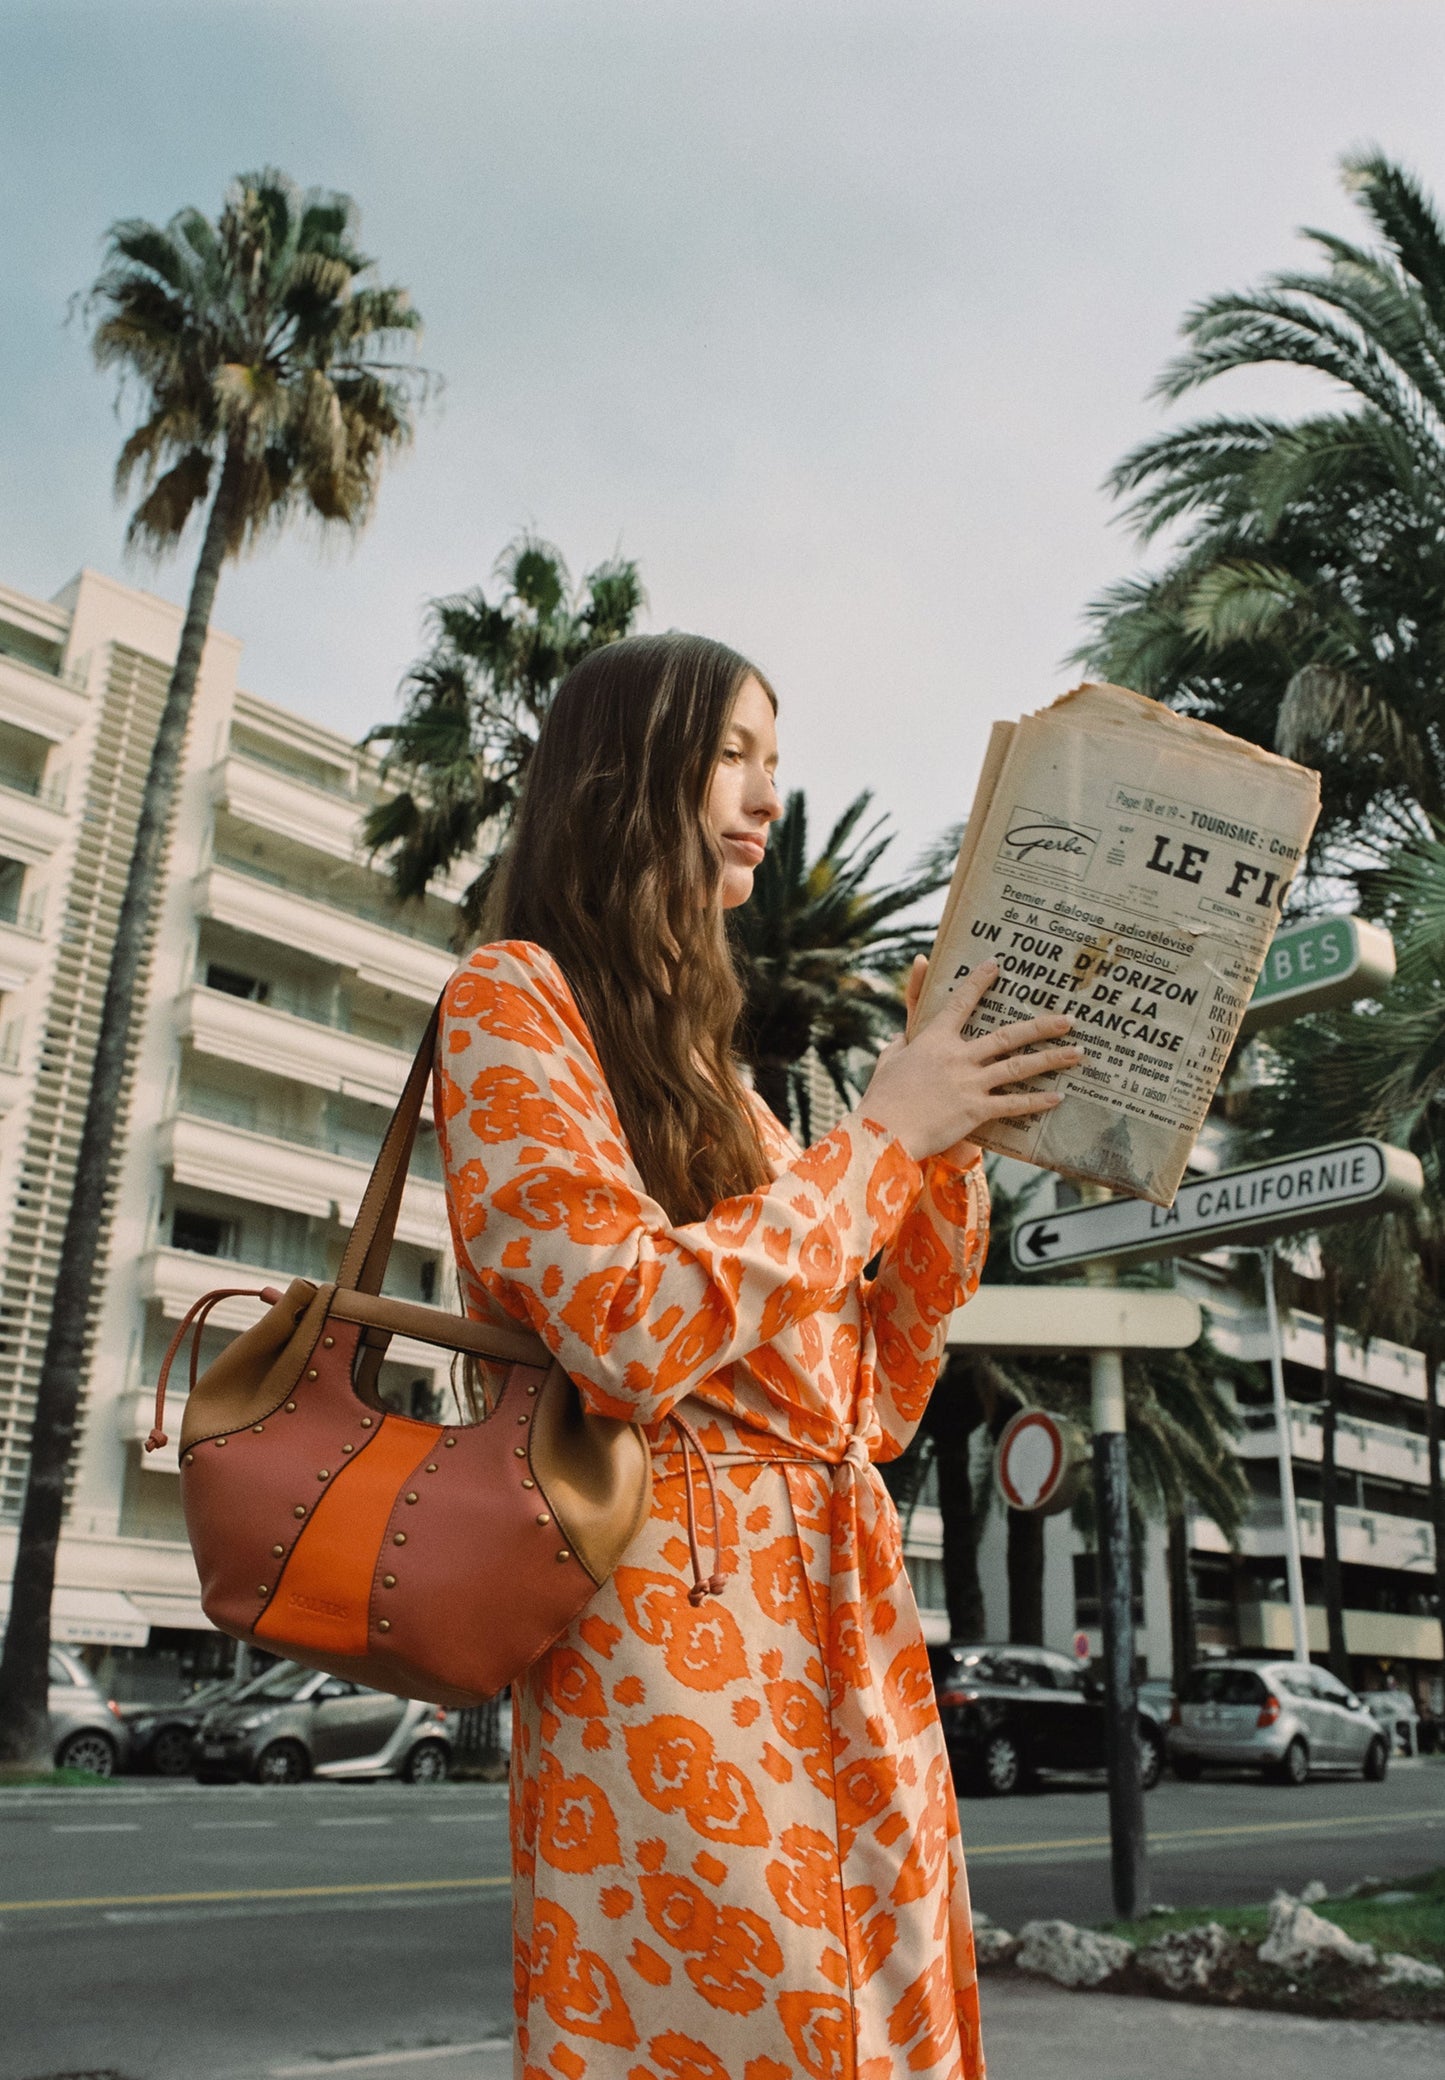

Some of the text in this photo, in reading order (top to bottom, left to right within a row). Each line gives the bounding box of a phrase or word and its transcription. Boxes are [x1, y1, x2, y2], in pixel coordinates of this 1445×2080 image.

[1005, 824, 1097, 861] Gerbe
[1146, 835, 1210, 884] LE
[1269, 838, 1304, 861] Cont
[1003, 884, 1046, 906] Premier
[1053, 901, 1105, 927] dialogue
[1004, 907, 1020, 921] de
[1049, 920, 1098, 946] Georges
[1106, 938, 1170, 969] ompidou
[970, 920, 1002, 942] UN
[1010, 932, 1064, 963] TOUR
[1074, 952, 1199, 1006] D'HORIZON
[1091, 984, 1124, 1007] DE
[1130, 998, 1158, 1019] LA
[1062, 999, 1184, 1052] FRANÇAISE
[1107, 1055, 1124, 1067] nos
[1128, 1063, 1170, 1083] principes
[1114, 1044, 1136, 1058] nous
[1137, 1052, 1174, 1071] pouvons
[1066, 1082, 1195, 1133] Paris-Caen en deux heures par
[1131, 1079, 1139, 1093] la
[1142, 1087, 1168, 1105] raison
[1197, 1156, 1366, 1218] CALIFORNIE
